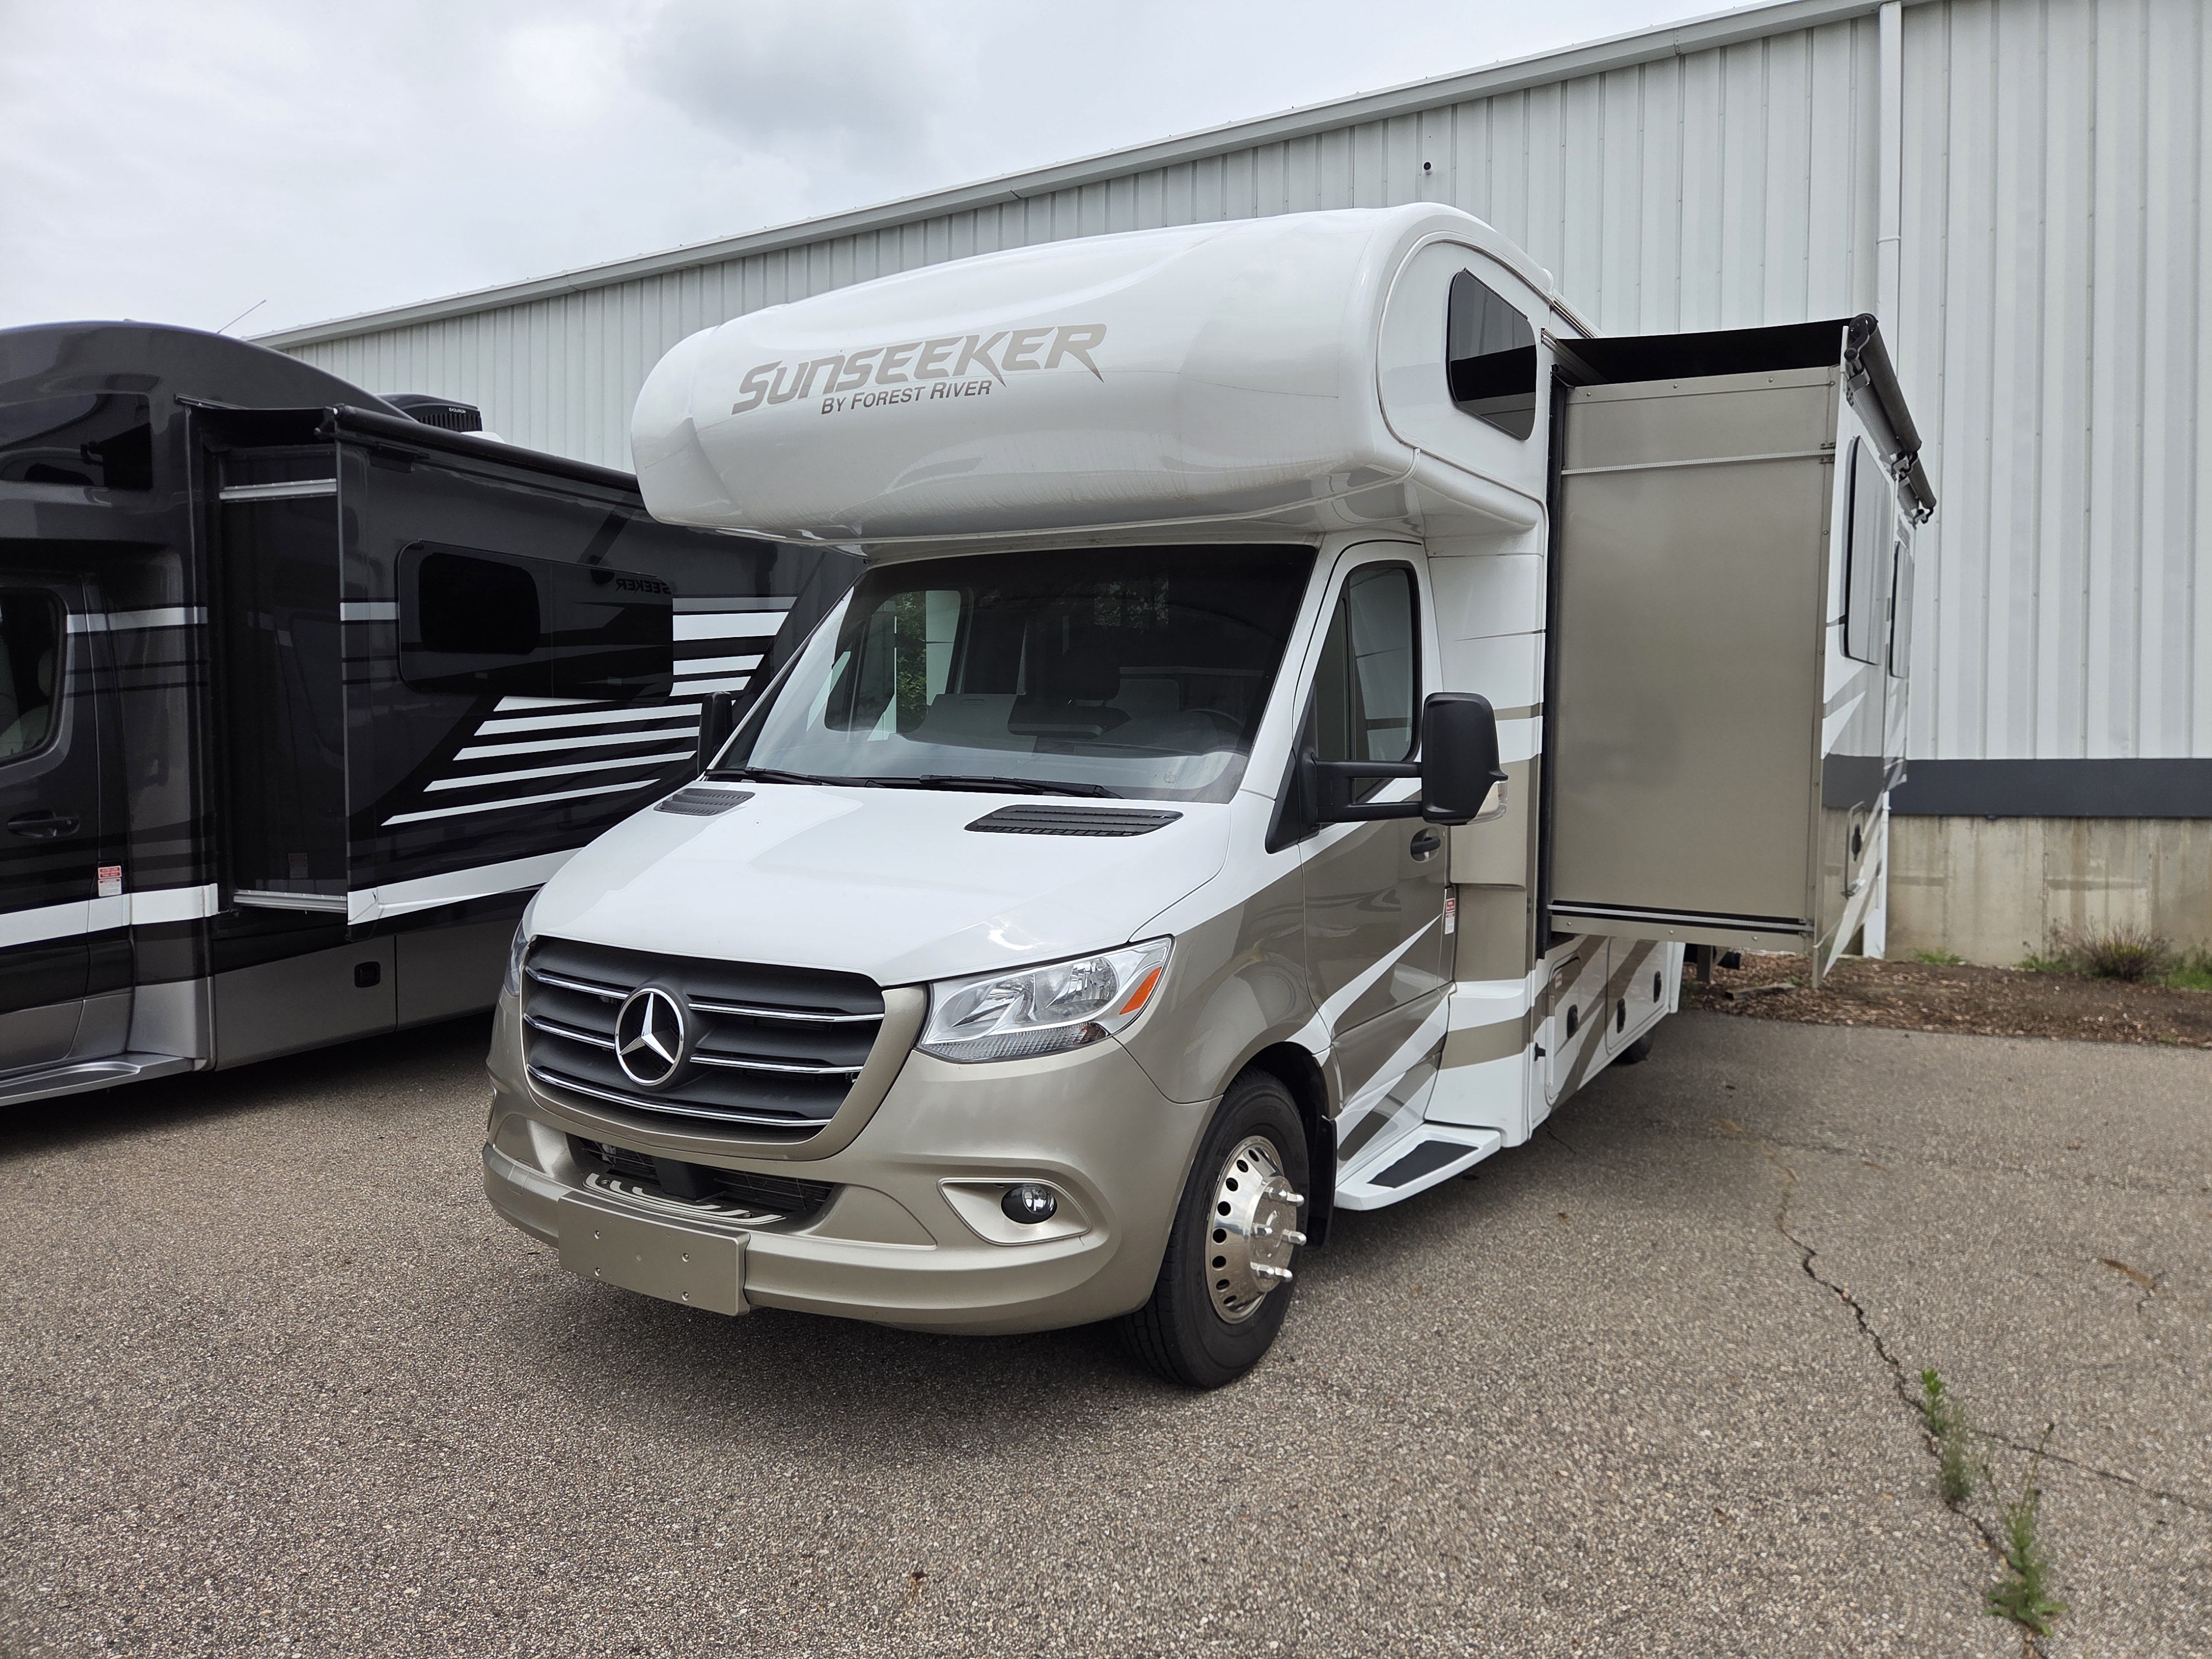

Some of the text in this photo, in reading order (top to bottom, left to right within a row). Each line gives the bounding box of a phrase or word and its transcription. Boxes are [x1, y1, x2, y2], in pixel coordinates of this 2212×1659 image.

[821, 380, 993, 415] BY FOREST RIVER
